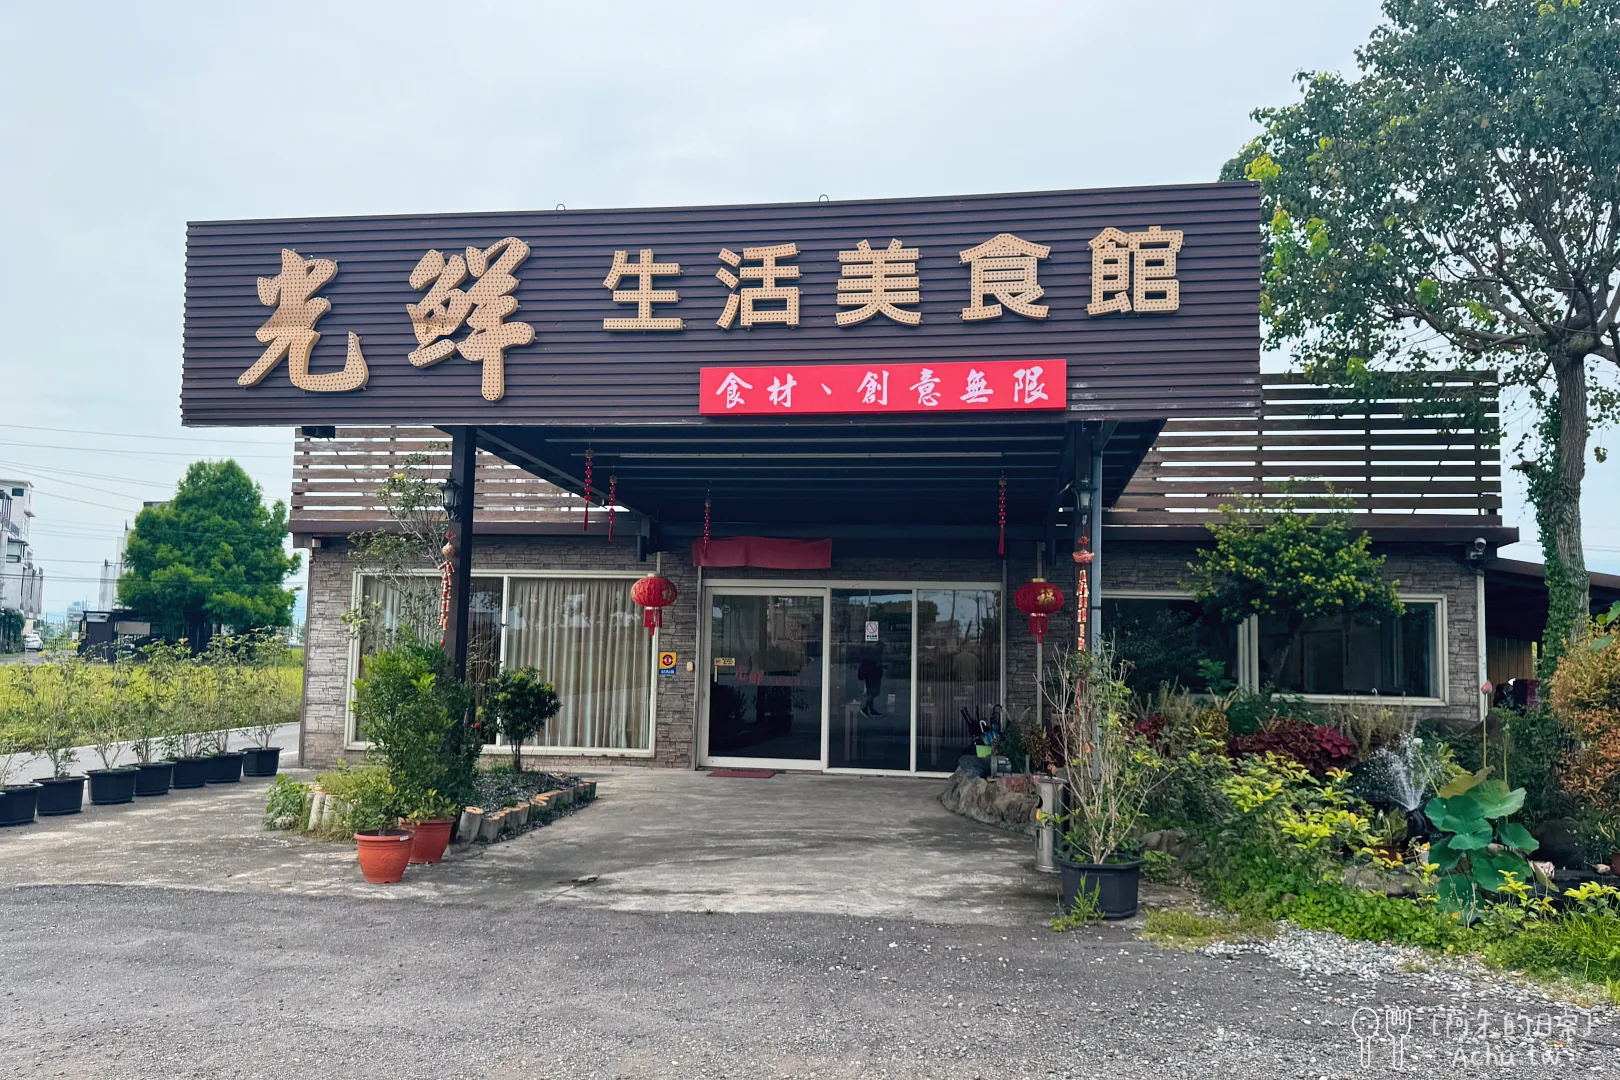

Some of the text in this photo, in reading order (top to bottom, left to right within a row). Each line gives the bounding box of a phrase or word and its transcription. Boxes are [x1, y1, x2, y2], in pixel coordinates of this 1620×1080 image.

[237, 225, 1184, 401] 光鮮 生活美食館
[715, 366, 1050, 410] 食材、創意無限
